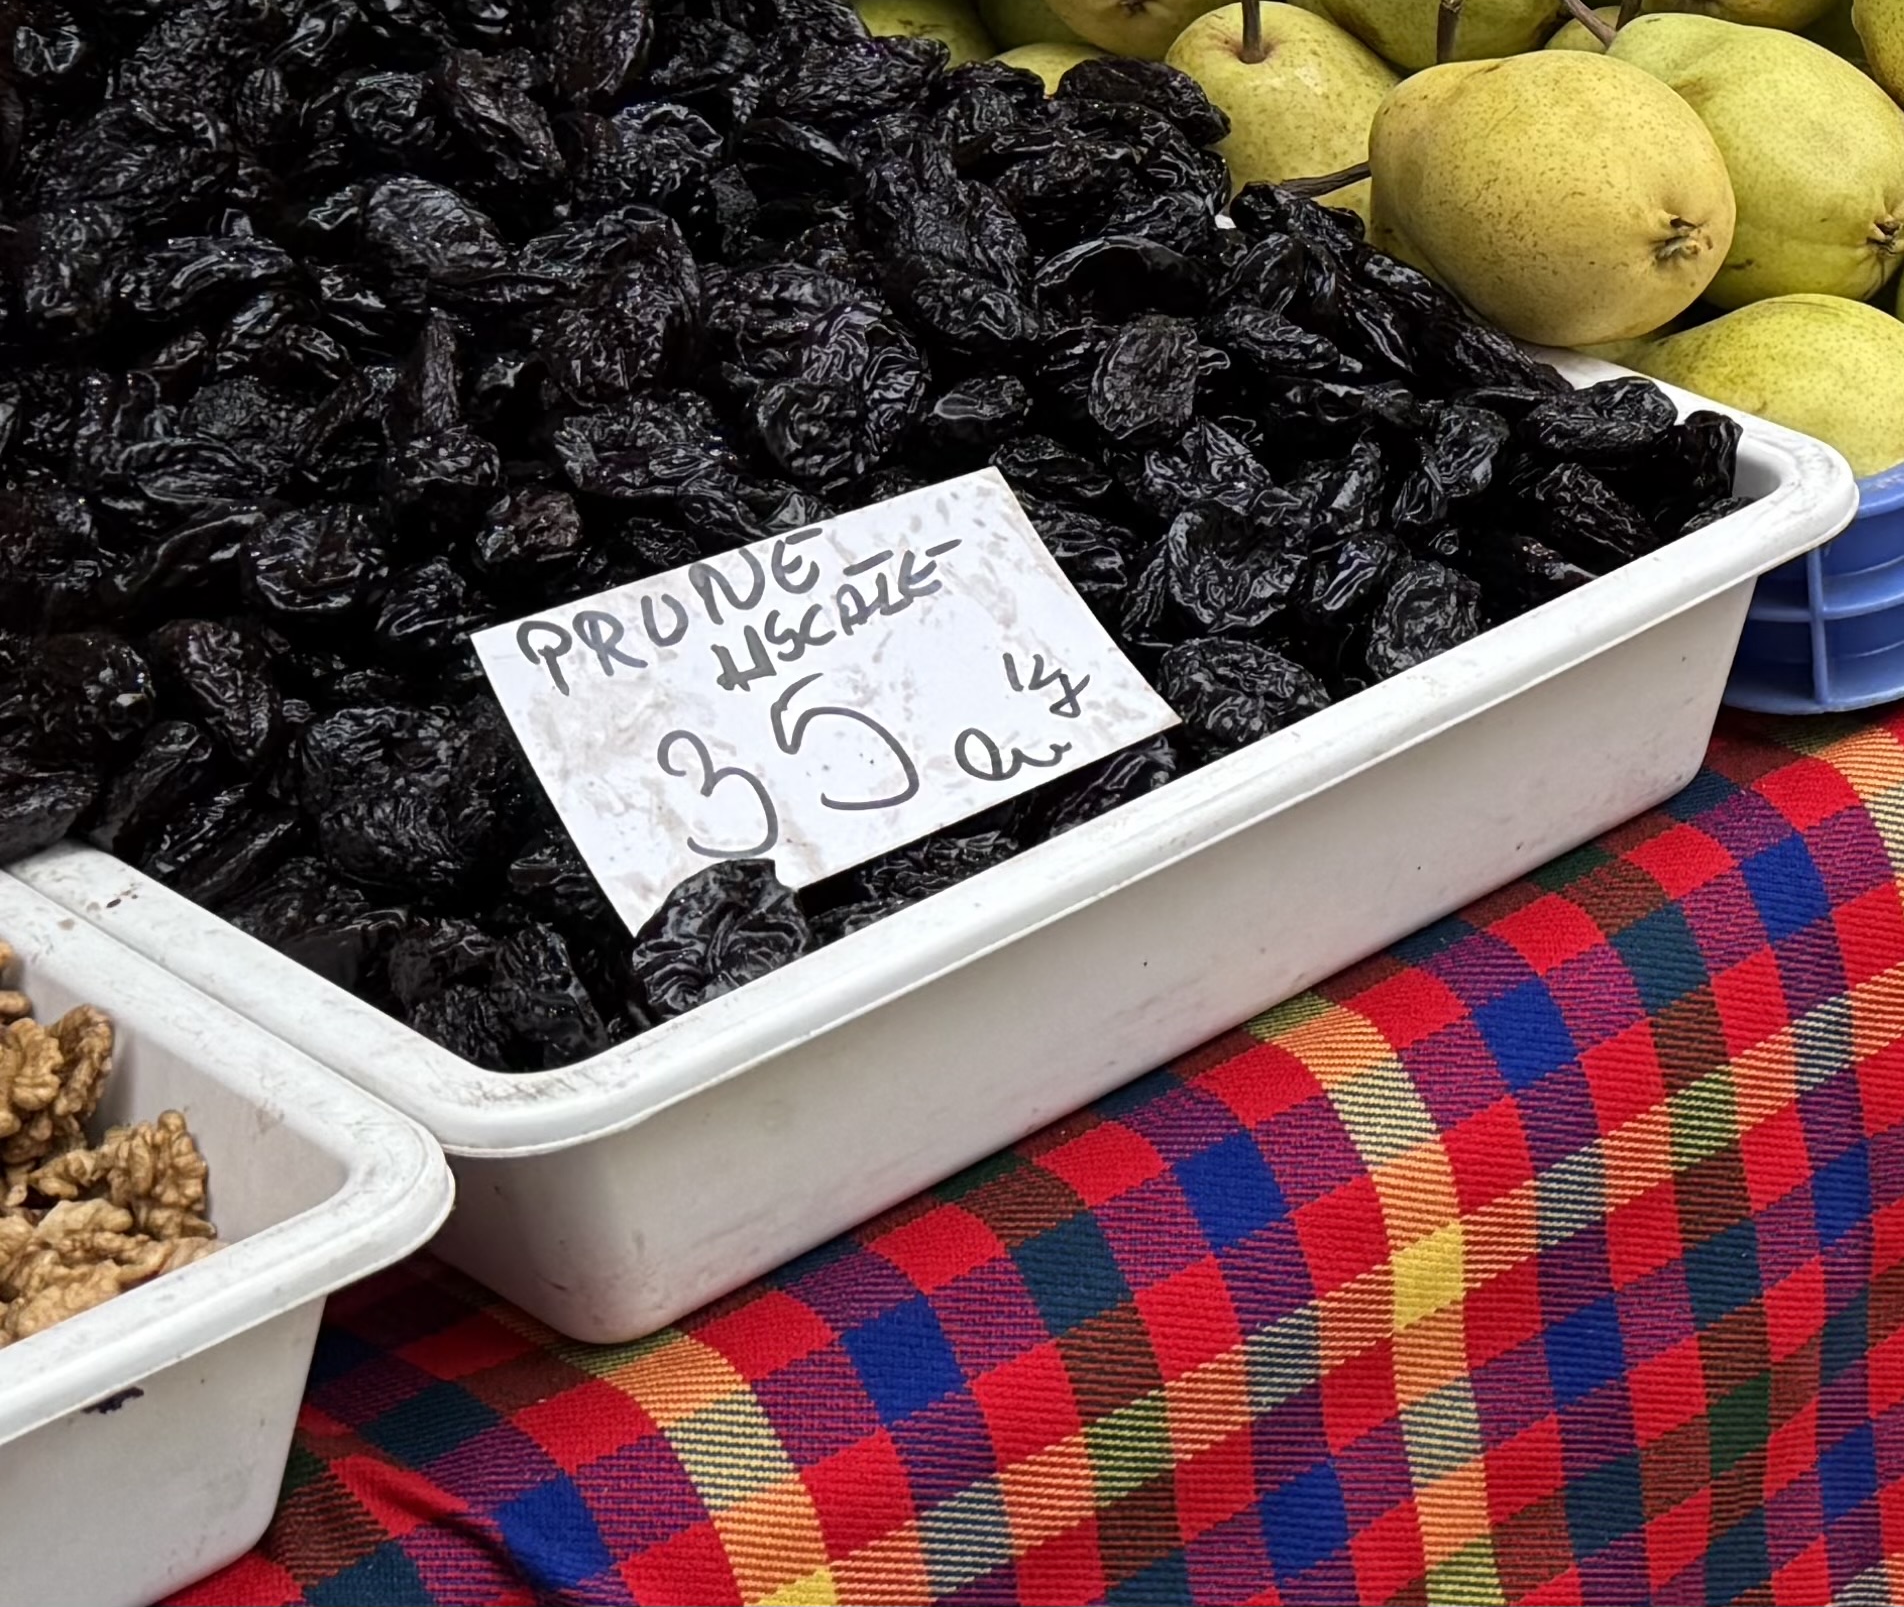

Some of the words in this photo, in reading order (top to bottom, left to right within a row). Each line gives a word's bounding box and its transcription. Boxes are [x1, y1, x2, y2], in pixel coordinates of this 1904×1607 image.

[515, 526, 824, 697] PRUNE
[709, 537, 963, 693] USCATE
[657, 672, 920, 860] 35
